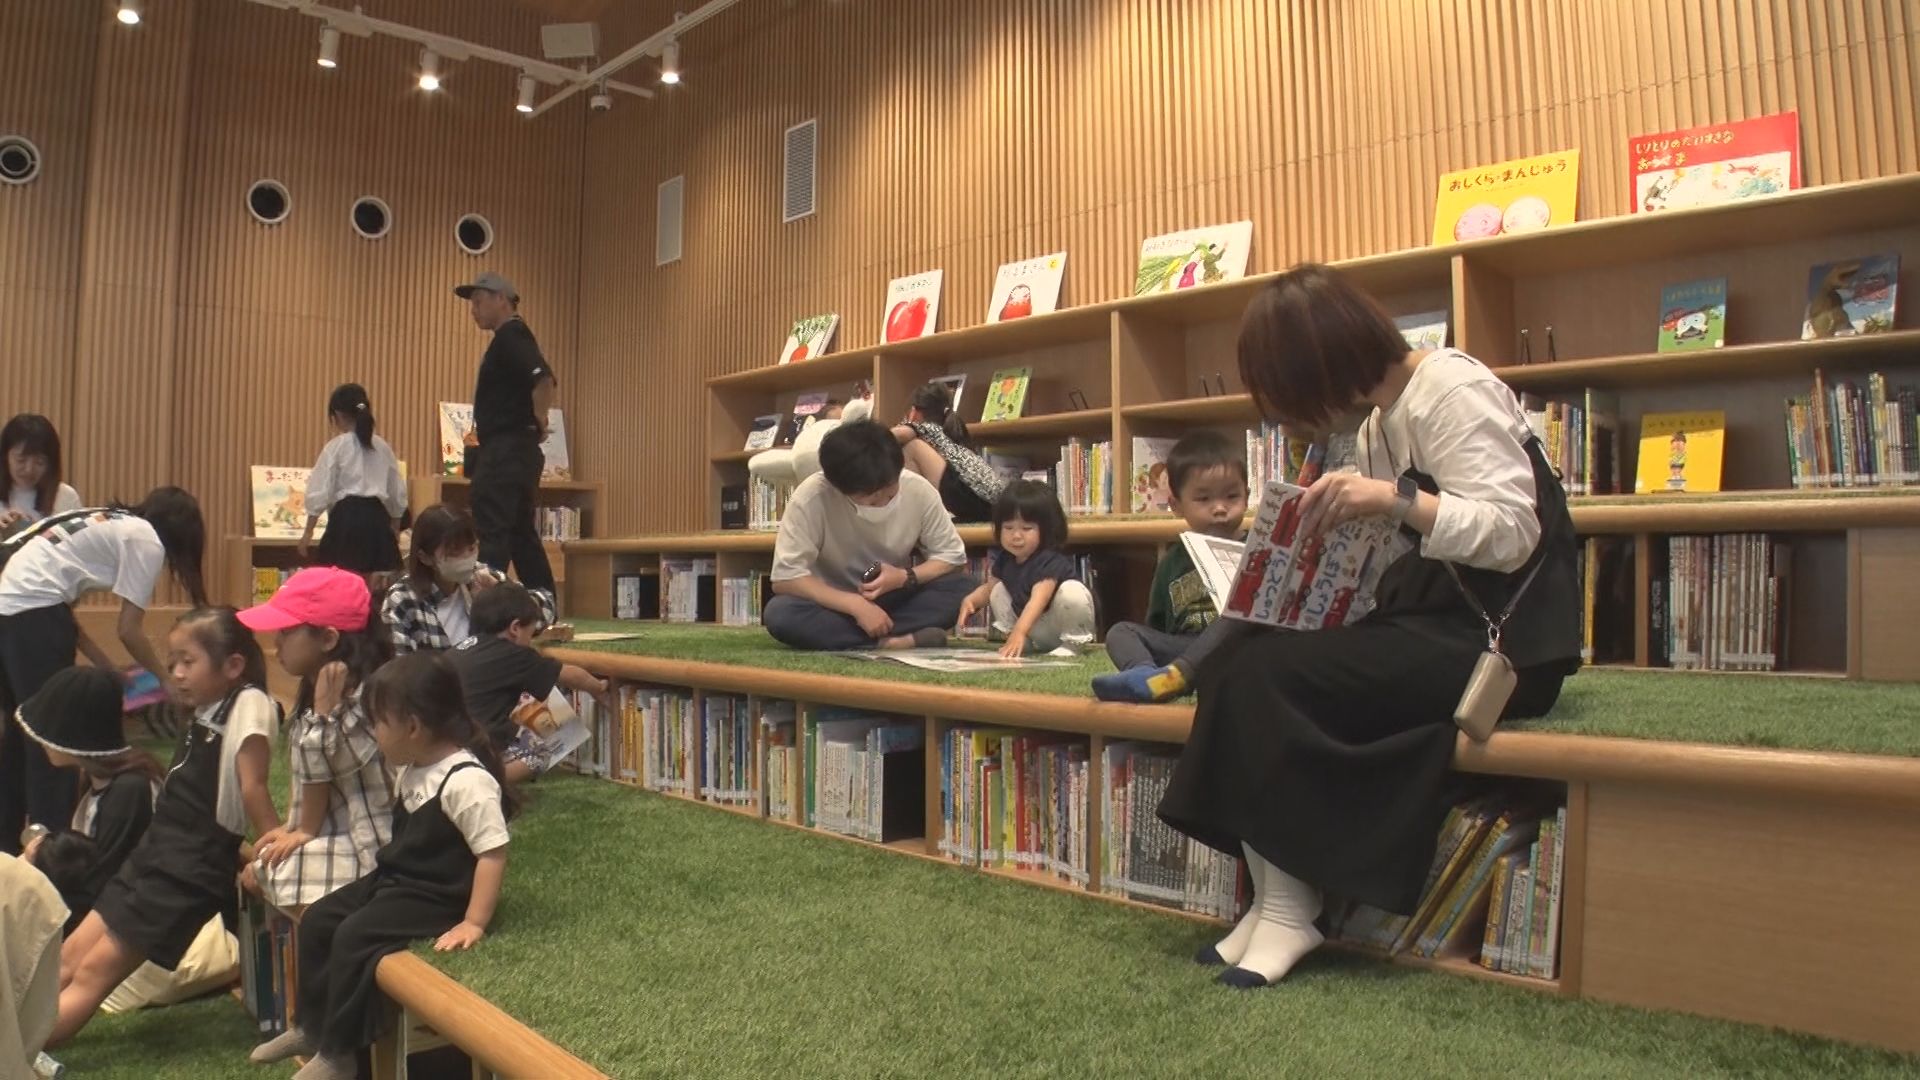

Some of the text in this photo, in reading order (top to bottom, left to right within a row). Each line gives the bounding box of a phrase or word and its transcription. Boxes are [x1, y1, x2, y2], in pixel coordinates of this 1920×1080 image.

[1448, 158, 1567, 192] おしくら・まんじゅう
